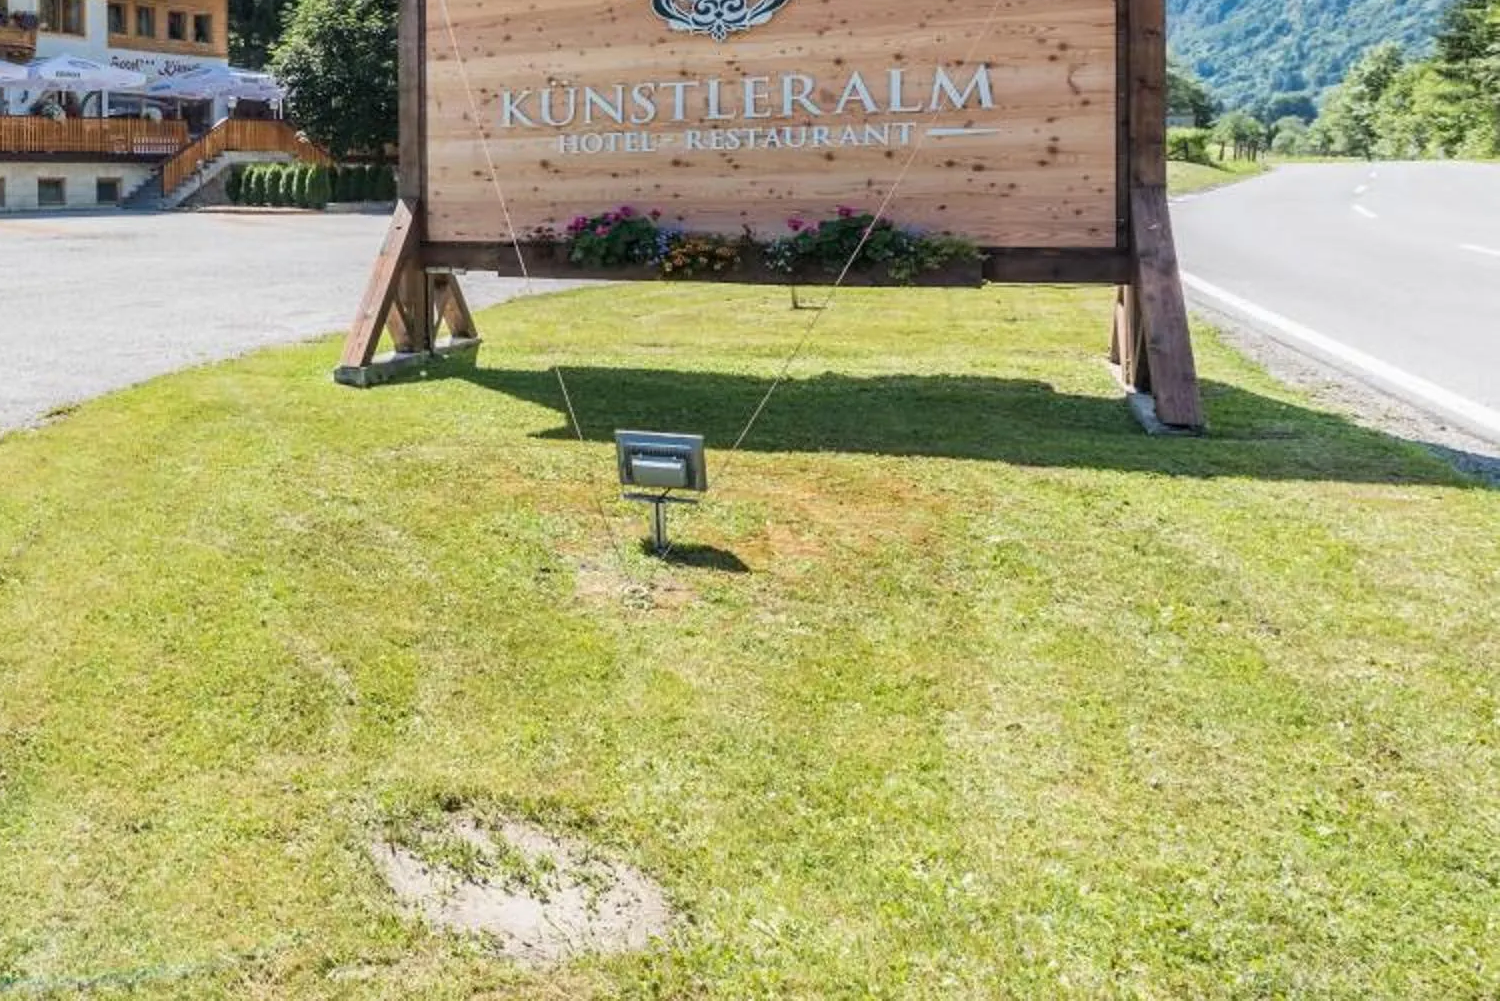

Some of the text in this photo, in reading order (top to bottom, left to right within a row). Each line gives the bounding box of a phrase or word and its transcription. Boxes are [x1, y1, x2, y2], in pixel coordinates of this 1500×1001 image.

[499, 63, 996, 128] KÜNSTLERALM
[557, 131, 657, 154] HOTEL
[685, 122, 918, 150] RESTAURANT
